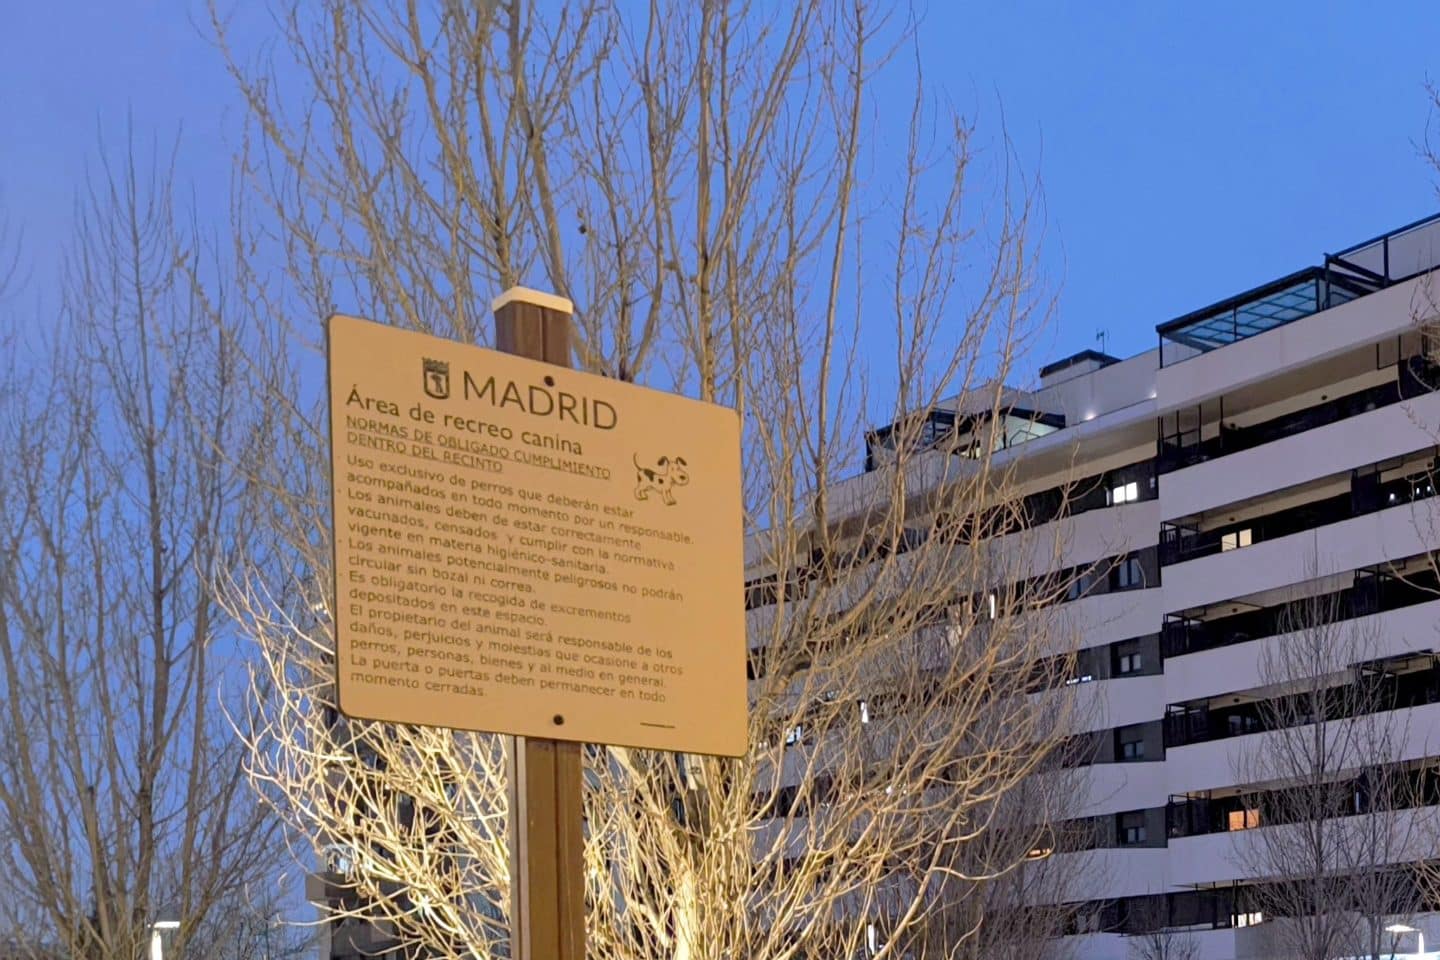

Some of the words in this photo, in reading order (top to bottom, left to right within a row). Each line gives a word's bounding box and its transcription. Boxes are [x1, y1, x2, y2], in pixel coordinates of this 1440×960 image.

[345, 383, 400, 417] Área
[408, 402, 435, 424] de
[443, 414, 513, 441] recreo
[520, 430, 583, 456] canina
[463, 370, 618, 430] MADRID
[345, 414, 409, 439] NORMAS
[413, 428, 433, 445] DE
[436, 433, 511, 461] OBLIGADO
[513, 449, 611, 481] CUMPLIMIENTO
[346, 430, 407, 455] DENTRO
[411, 444, 439, 461] DEL
[442, 450, 503, 474] RECINTO
[346, 454, 374, 470] Uso
[378, 462, 445, 483] exclusivo
[448, 473, 466, 487] de
[470, 479, 514, 497] perros
[517, 488, 543, 502] que
[546, 492, 599, 512] deberán
[602, 504, 634, 518] estar
[346, 471, 446, 499] acompañados
[450, 491, 468, 502] en
[471, 494, 503, 510] todo
[507, 502, 569, 521] momento
[573, 514, 595, 526] por
[598, 519, 615, 530] un
[618, 522, 694, 545] responsable.
[347, 487, 372, 502] Los
[377, 494, 441, 514] animales
[445, 505, 487, 522] deben
[492, 513, 508, 527] de
[512, 519, 546, 532] estar
[550, 525, 641, 551] correctamente
[347, 505, 429, 530] vacunados,
[434, 520, 498, 540] censados
[505, 533, 515, 545] y
[519, 535, 568, 552] cumplir
[571, 544, 594, 556] con
[598, 548, 609, 560] la
[613, 552, 675, 571] normativa
[347, 522, 402, 540] vigente
[406, 532, 424, 543] en
[428, 536, 482, 554] materia
[348, 536, 373, 552] Los
[377, 543, 442, 563] animales
[446, 555, 550, 581] potencialmente
[553, 572, 618, 591] peligrosos
[621, 583, 637, 594] no
[641, 586, 683, 601] podrán
[348, 553, 402, 572] circular
[407, 564, 427, 576] sin
[431, 567, 469, 583] bozal
[472, 575, 486, 585] ni
[489, 578, 534, 593] correa.
[348, 569, 366, 583] Es
[370, 574, 447, 596] obligatorio
[451, 586, 463, 599] la
[468, 590, 526, 608] recogida
[529, 598, 546, 611] de
[549, 603, 631, 624] excrementos
[348, 587, 435, 610] depositados
[439, 602, 457, 613] en
[461, 605, 491, 618] este
[349, 602, 363, 616] El
[368, 608, 446, 628] propietario
[450, 618, 471, 631] del
[475, 623, 521, 638] animal
[525, 630, 553, 643] será
[557, 635, 633, 654] responsable
[636, 644, 652, 657] de
[655, 647, 673, 659] los
[349, 620, 398, 639] daños,
[403, 629, 471, 647] perjuicios
[475, 639, 484, 651] y
[487, 640, 551, 658] molestias
[554, 650, 579, 662] que
[583, 653, 638, 670] ocasione
[641, 661, 649, 671] a
[652, 663, 684, 676] otros
[349, 638, 401, 655] perros,
[406, 646, 474, 665] personas,
[479, 652, 523, 670] bienes
[527, 662, 534, 673] y
[539, 662, 552, 673] al
[555, 665, 595, 679] medio
[598, 671, 614, 681] en
[350, 654, 367, 666] La
[372, 658, 419, 673] puerta
[424, 664, 434, 675] o
[437, 666, 490, 682] puertas
[493, 671, 535, 686] deben
[539, 679, 616, 697] permanecer
[618, 688, 635, 699] en
[638, 689, 666, 703] todo
[350, 671, 420, 689] momento
